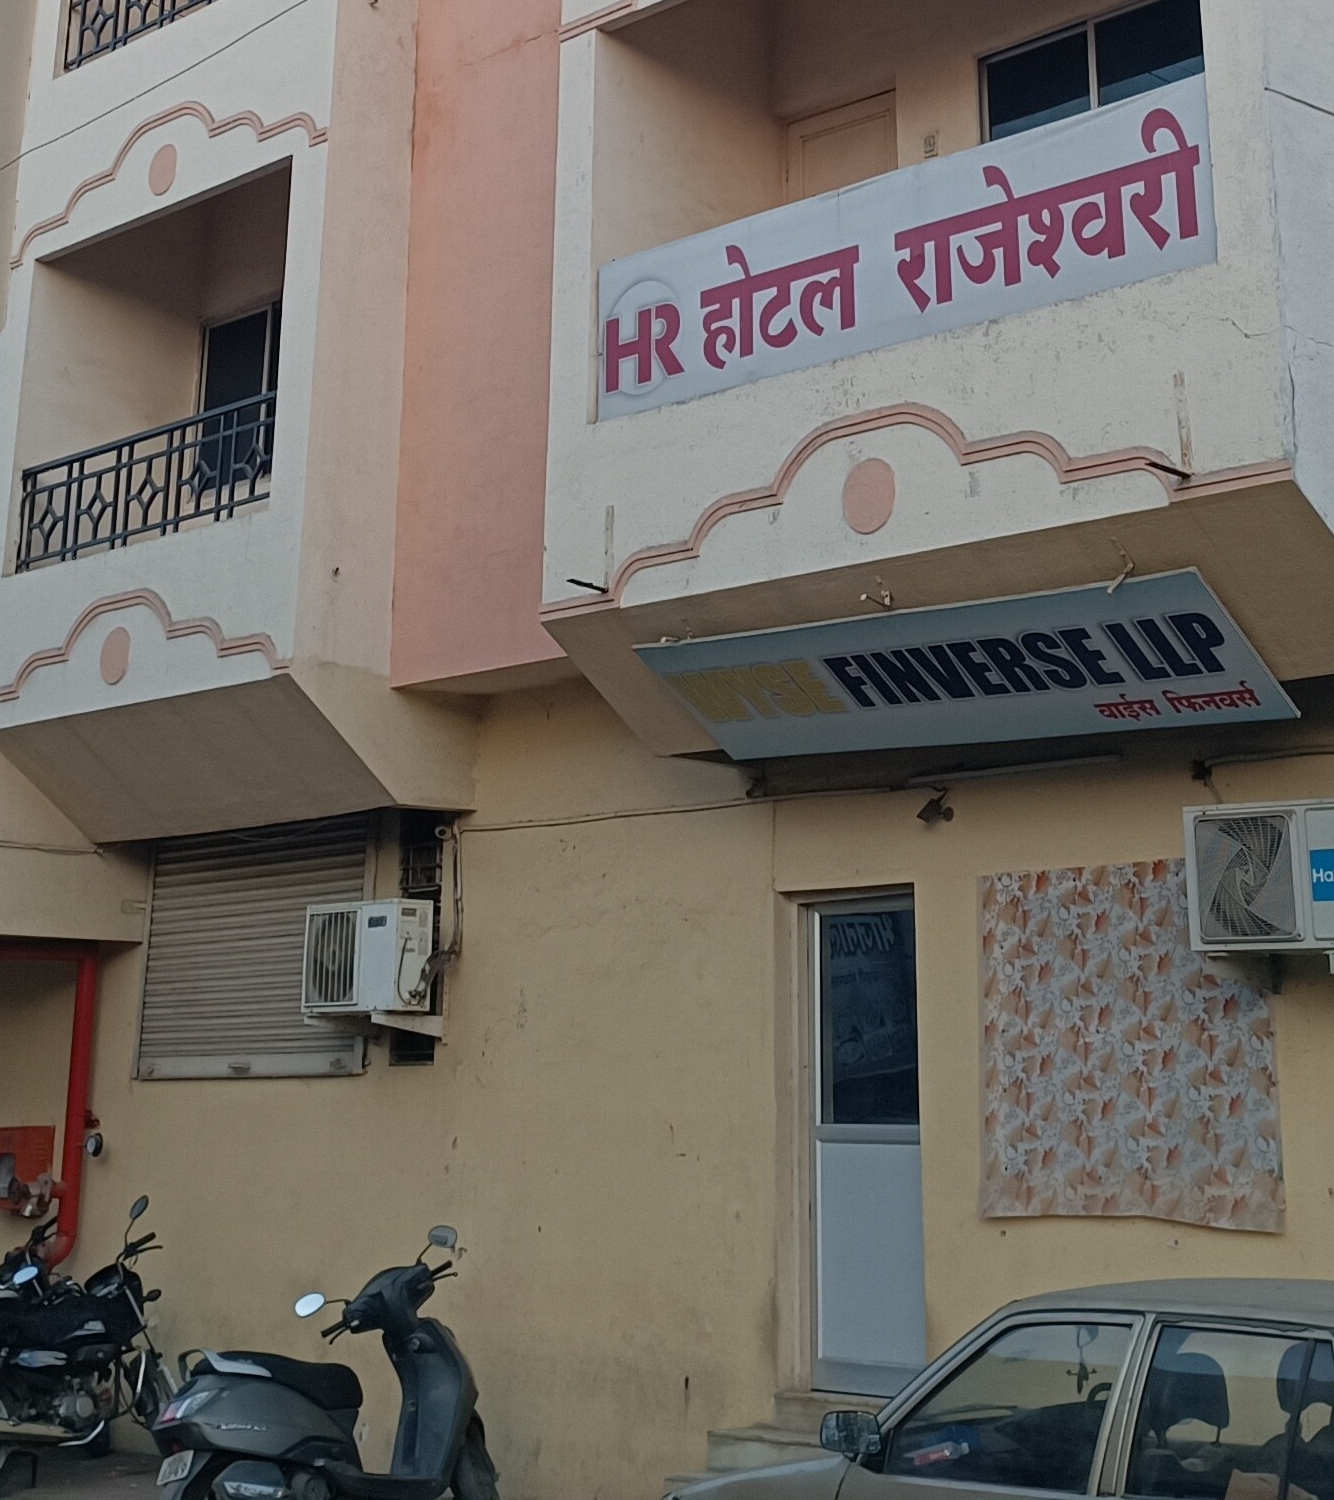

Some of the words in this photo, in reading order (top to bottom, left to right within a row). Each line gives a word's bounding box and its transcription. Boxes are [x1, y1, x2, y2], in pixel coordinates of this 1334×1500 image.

[700, 244, 859, 370] होटल
[894, 107, 1200, 313] राजेश्वरी
[605, 302, 684, 394] HR
[667, 660, 846, 722] WYSE
[822, 627, 1126, 708] FINVERSE
[1104, 612, 1226, 683] LLP
[1094, 693, 1162, 722] वाईस
[1161, 680, 1262, 714] फिनवर्स
